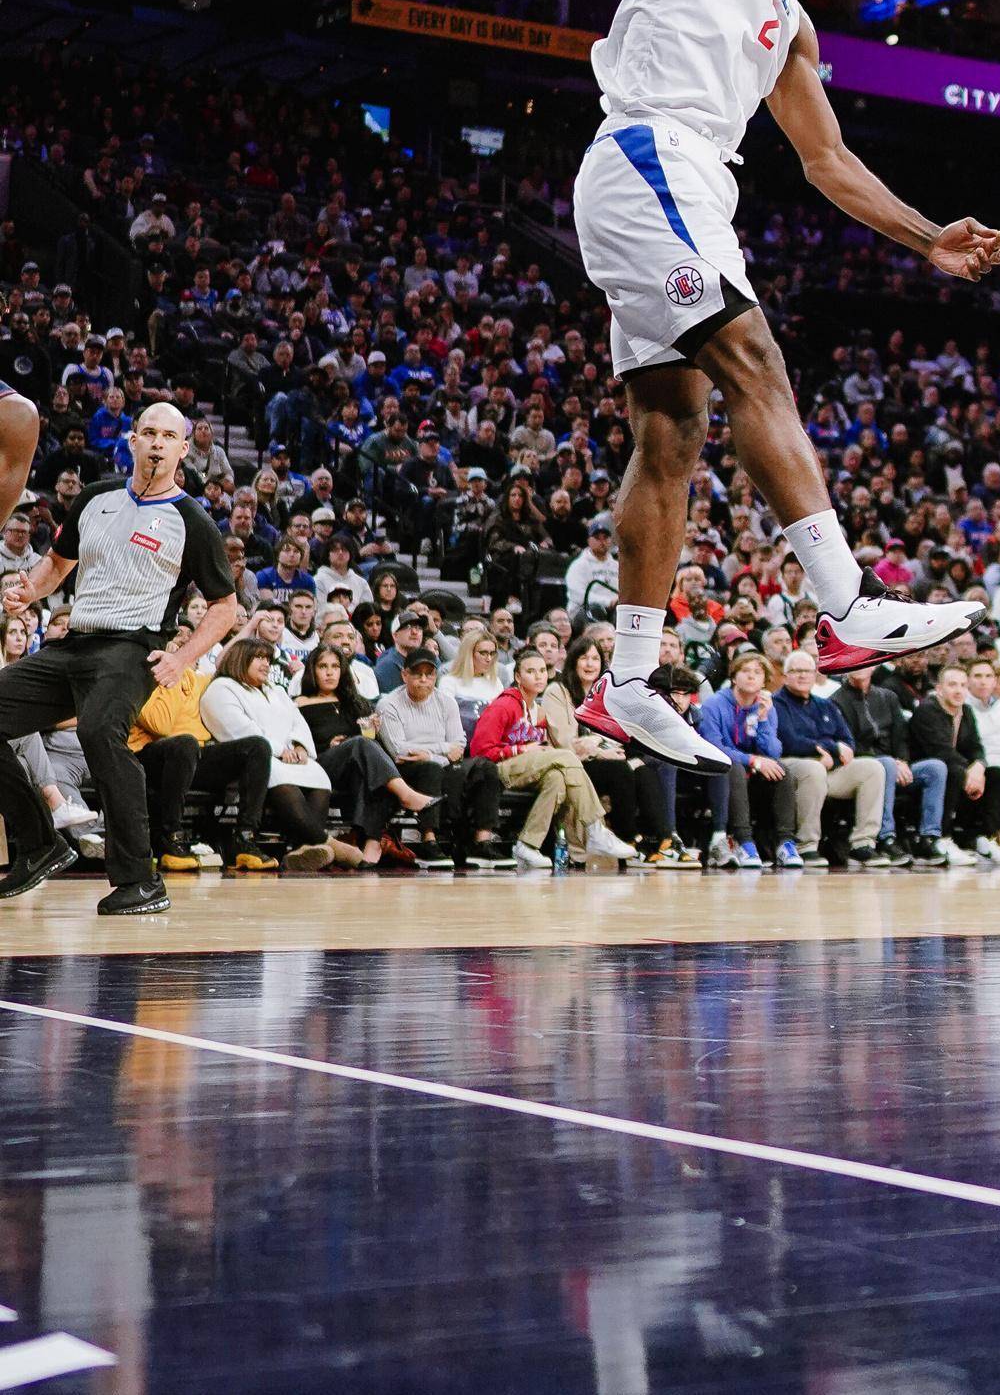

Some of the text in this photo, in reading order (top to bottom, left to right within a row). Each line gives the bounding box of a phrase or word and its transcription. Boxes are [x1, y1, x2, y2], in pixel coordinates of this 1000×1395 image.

[408, 7, 447, 31] EVERY
[450, 15, 473, 38] DAY
[528, 29, 552, 47] DAY
[944, 83, 1000, 113] CITY
